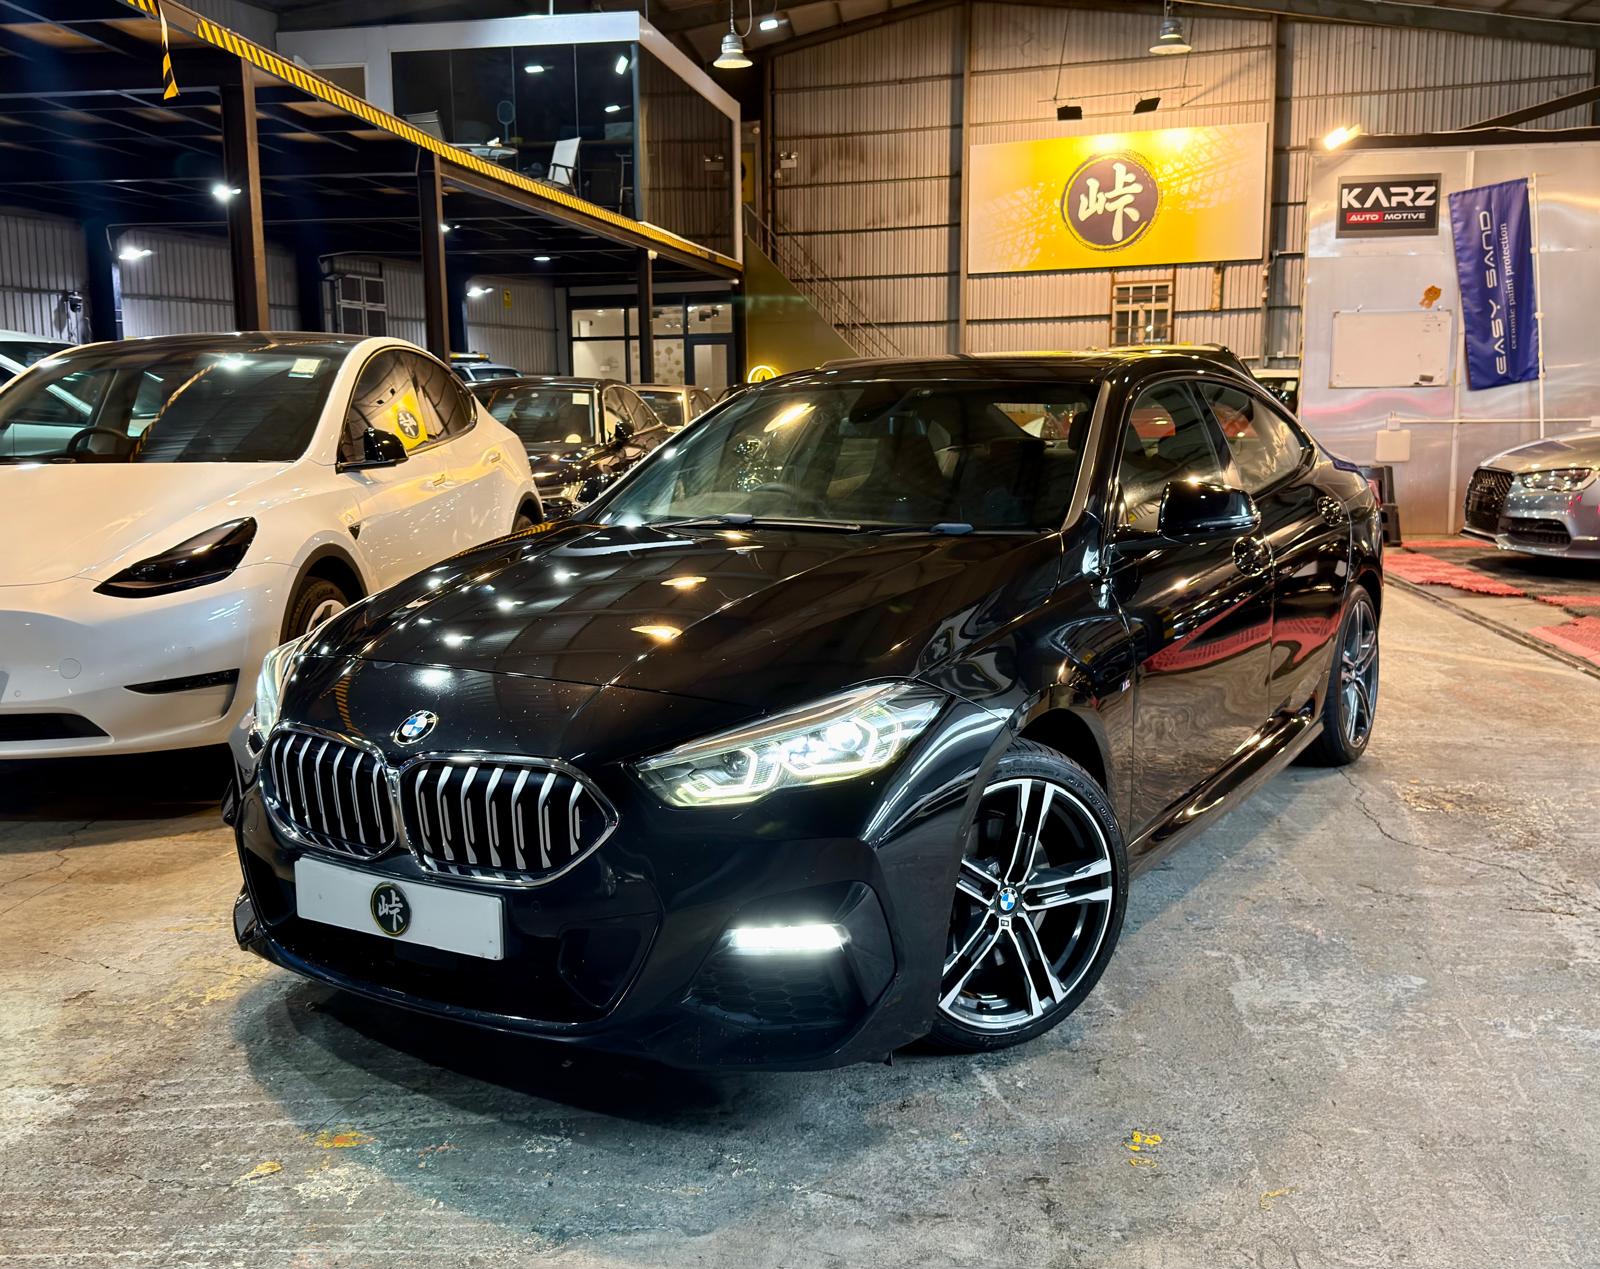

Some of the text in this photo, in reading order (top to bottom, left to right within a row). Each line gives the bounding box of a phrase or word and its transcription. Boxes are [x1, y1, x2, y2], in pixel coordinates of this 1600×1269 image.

[1078, 162, 1144, 242] 峠
[1341, 186, 1436, 209] KARZ
[1349, 212, 1426, 222] AUTO MOTIVE
[1500, 223, 1515, 276] protection
[1505, 278, 1517, 306] paint
[1488, 299, 1507, 375] EASY
[377, 889, 404, 932] 峠
